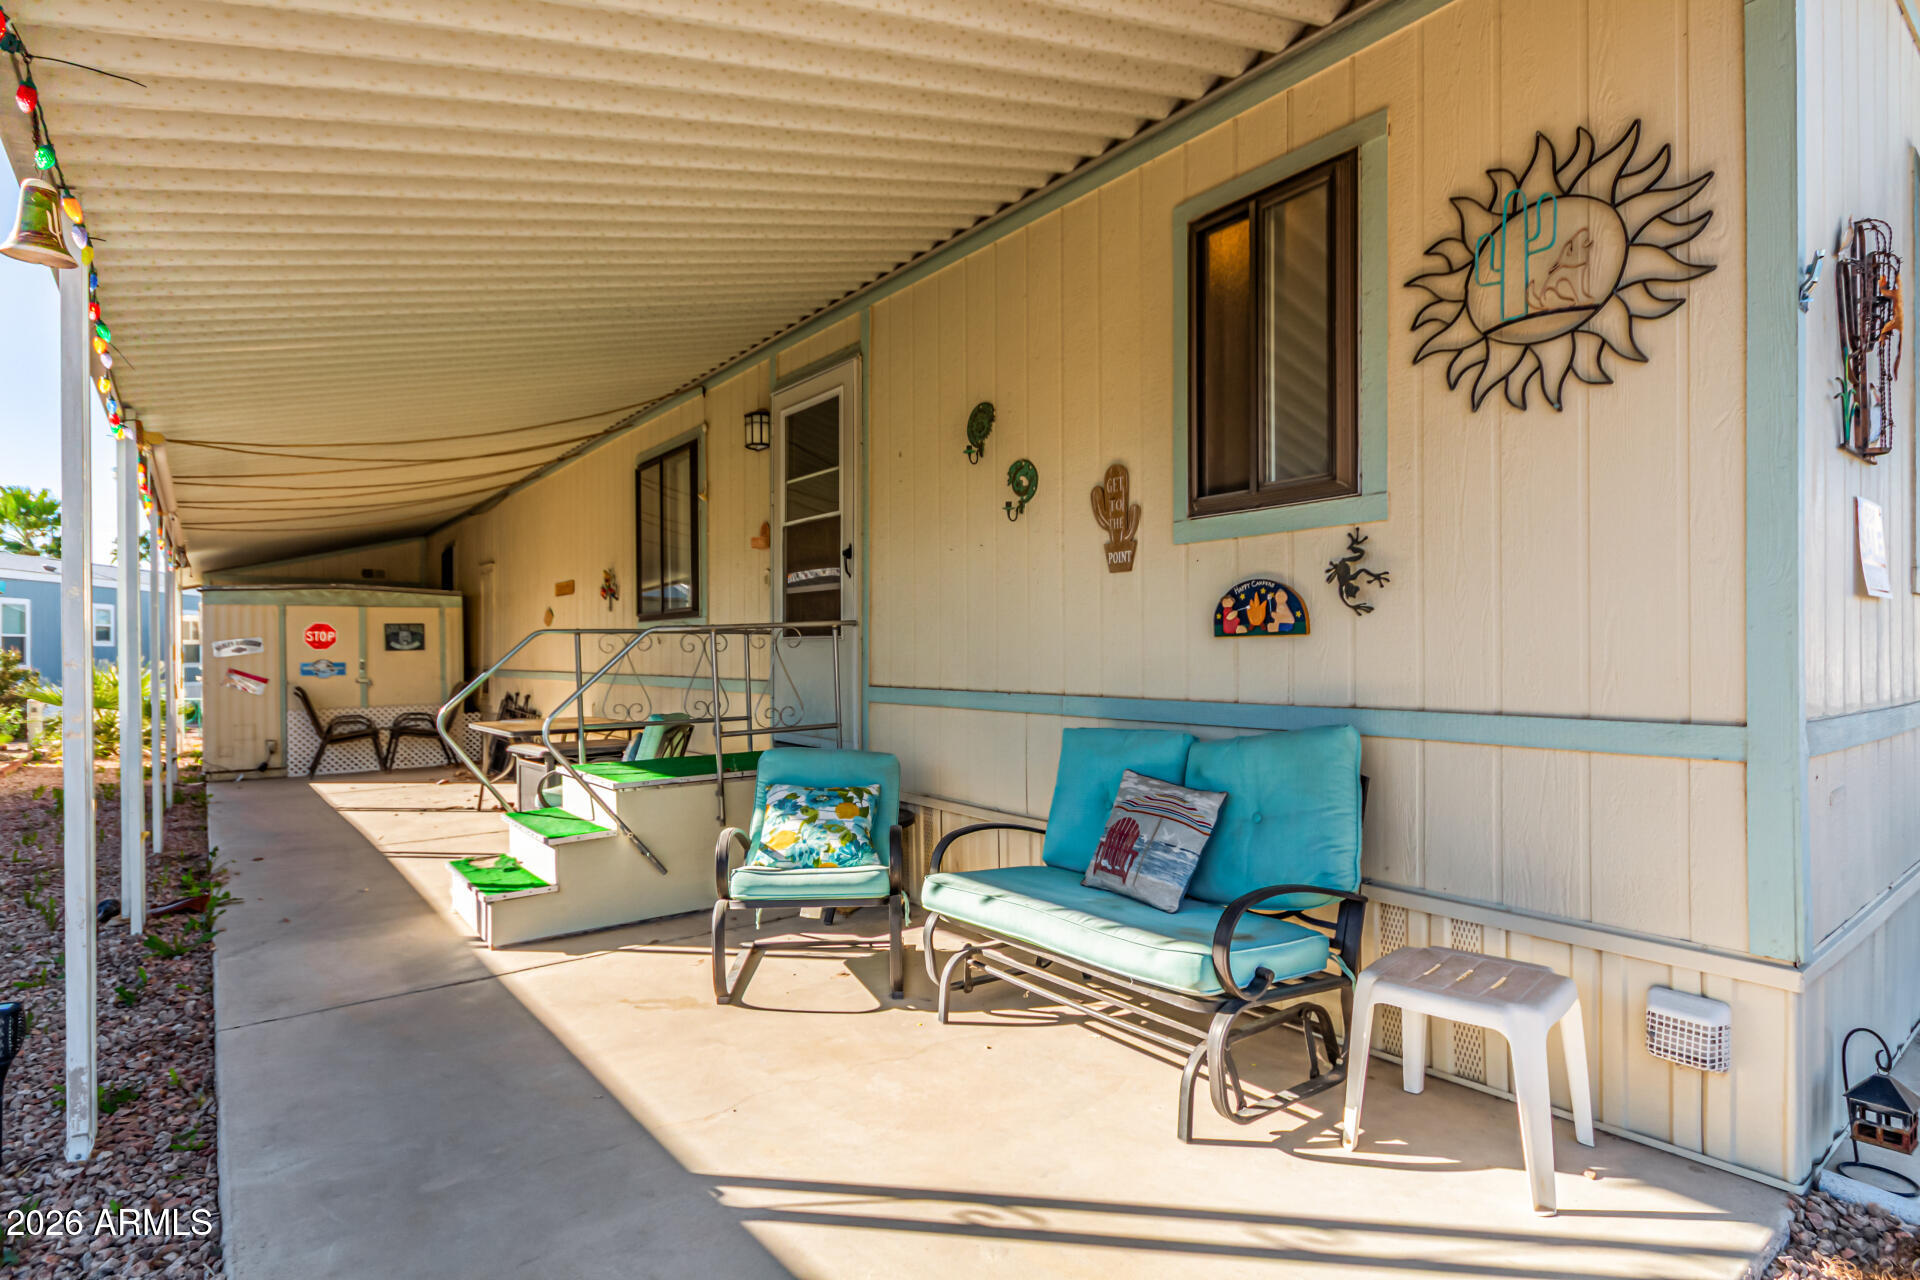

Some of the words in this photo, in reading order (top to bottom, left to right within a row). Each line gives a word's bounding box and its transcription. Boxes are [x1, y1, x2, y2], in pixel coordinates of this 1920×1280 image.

[1106, 476, 1124, 493] GET
[1109, 499, 1125, 512] TO
[1109, 517, 1124, 529] THE
[1108, 550, 1132, 564] POINT
[306, 631, 335, 642] STOP
